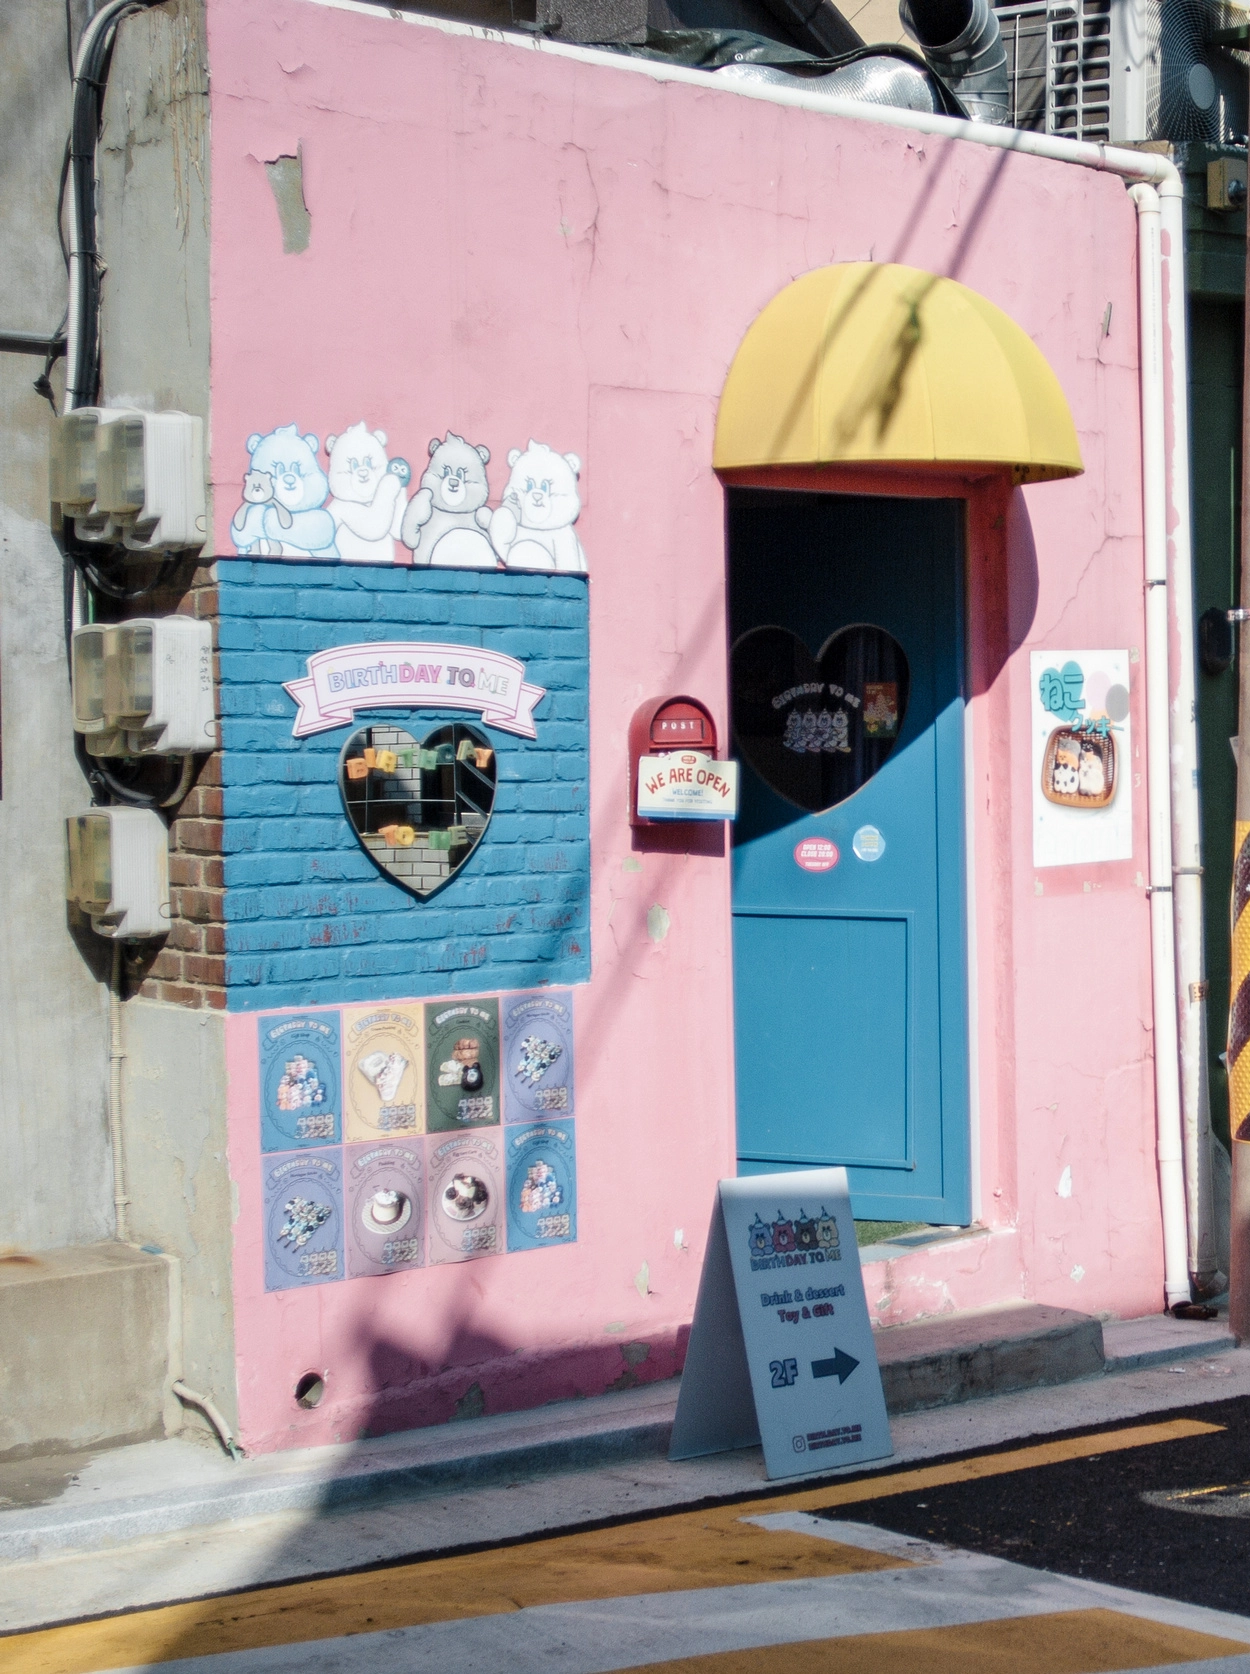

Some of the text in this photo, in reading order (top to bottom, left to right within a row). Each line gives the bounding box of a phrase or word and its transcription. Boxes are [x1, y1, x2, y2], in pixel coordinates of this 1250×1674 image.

[328, 662, 509, 696] BIRTHDAY TO ME
[1040, 673, 1086, 712] ねこ
[661, 721, 695, 730] POST
[1069, 713, 1124, 738] クッキー
[645, 767, 731, 798] WE ARE OPEN
[671, 789, 704, 797] WELCOME!
[808, 1251, 825, 1264] TO
[760, 1284, 846, 1307] Drink & dessert
[777, 1302, 835, 1324] Toy & Gift
[769, 1357, 799, 1389] 2F
